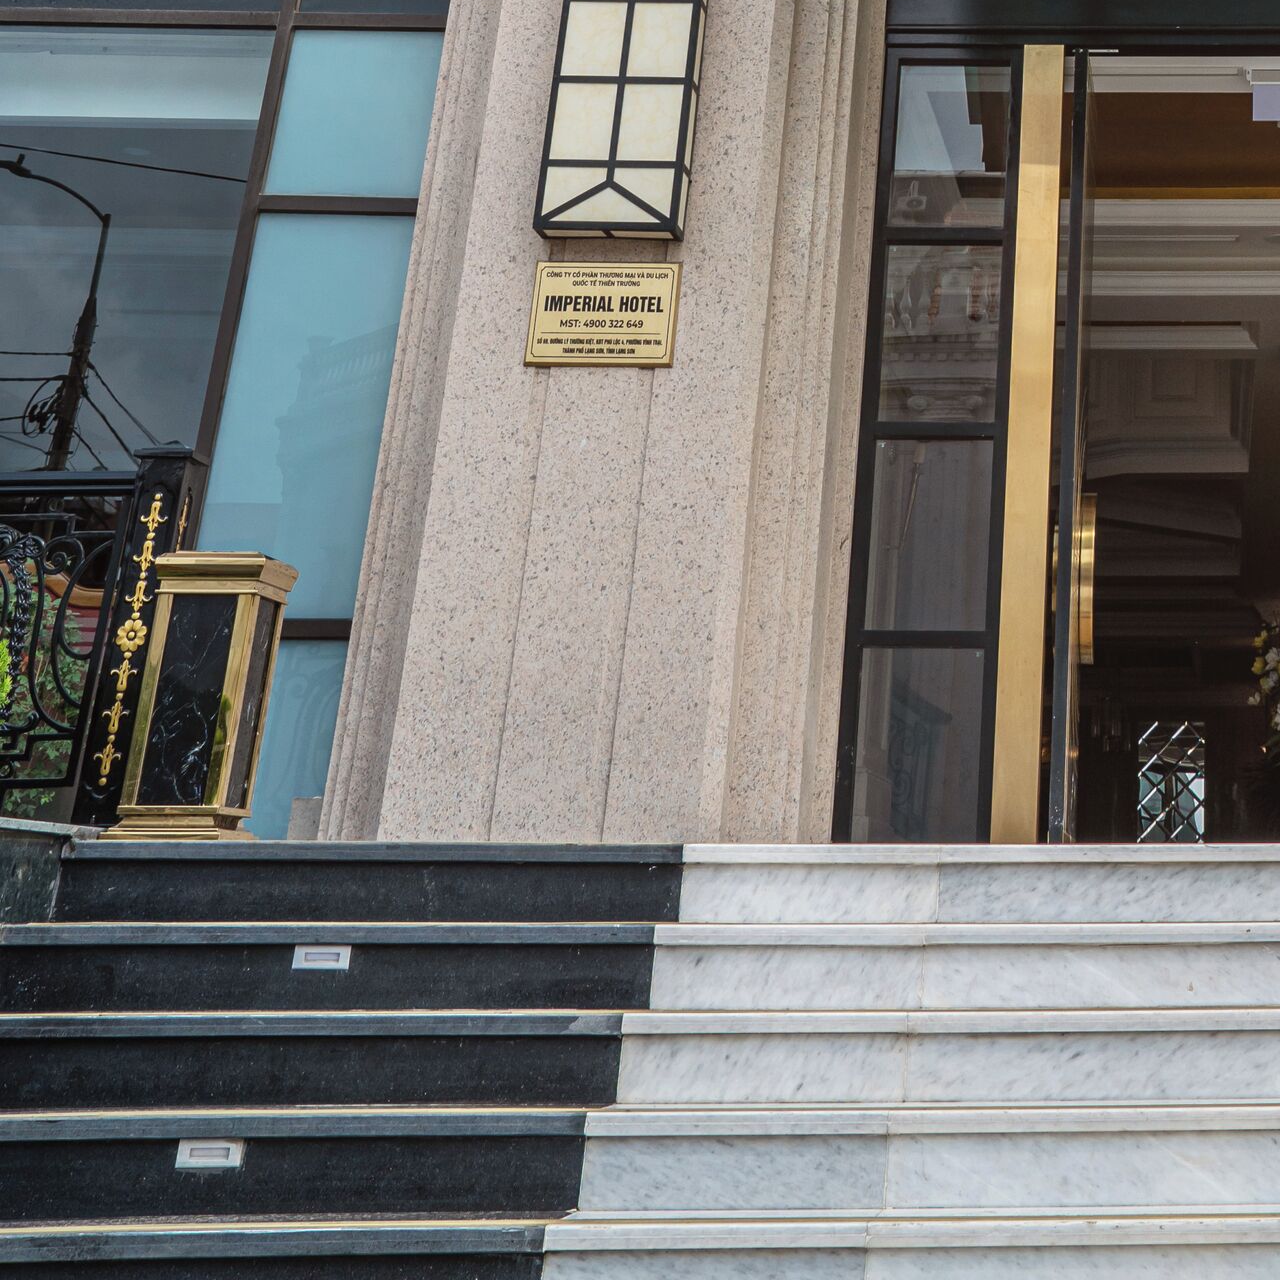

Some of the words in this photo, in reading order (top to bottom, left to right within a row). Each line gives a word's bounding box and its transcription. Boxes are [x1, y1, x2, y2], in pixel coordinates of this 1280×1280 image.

[655, 272, 669, 280] LỊCH
[544, 295, 614, 312] IMPERIAL
[619, 296, 664, 313] HOTEL
[559, 319, 581, 328] MST:
[583, 319, 606, 328] 4900
[608, 320, 624, 328] 322
[626, 320, 644, 329] 649
